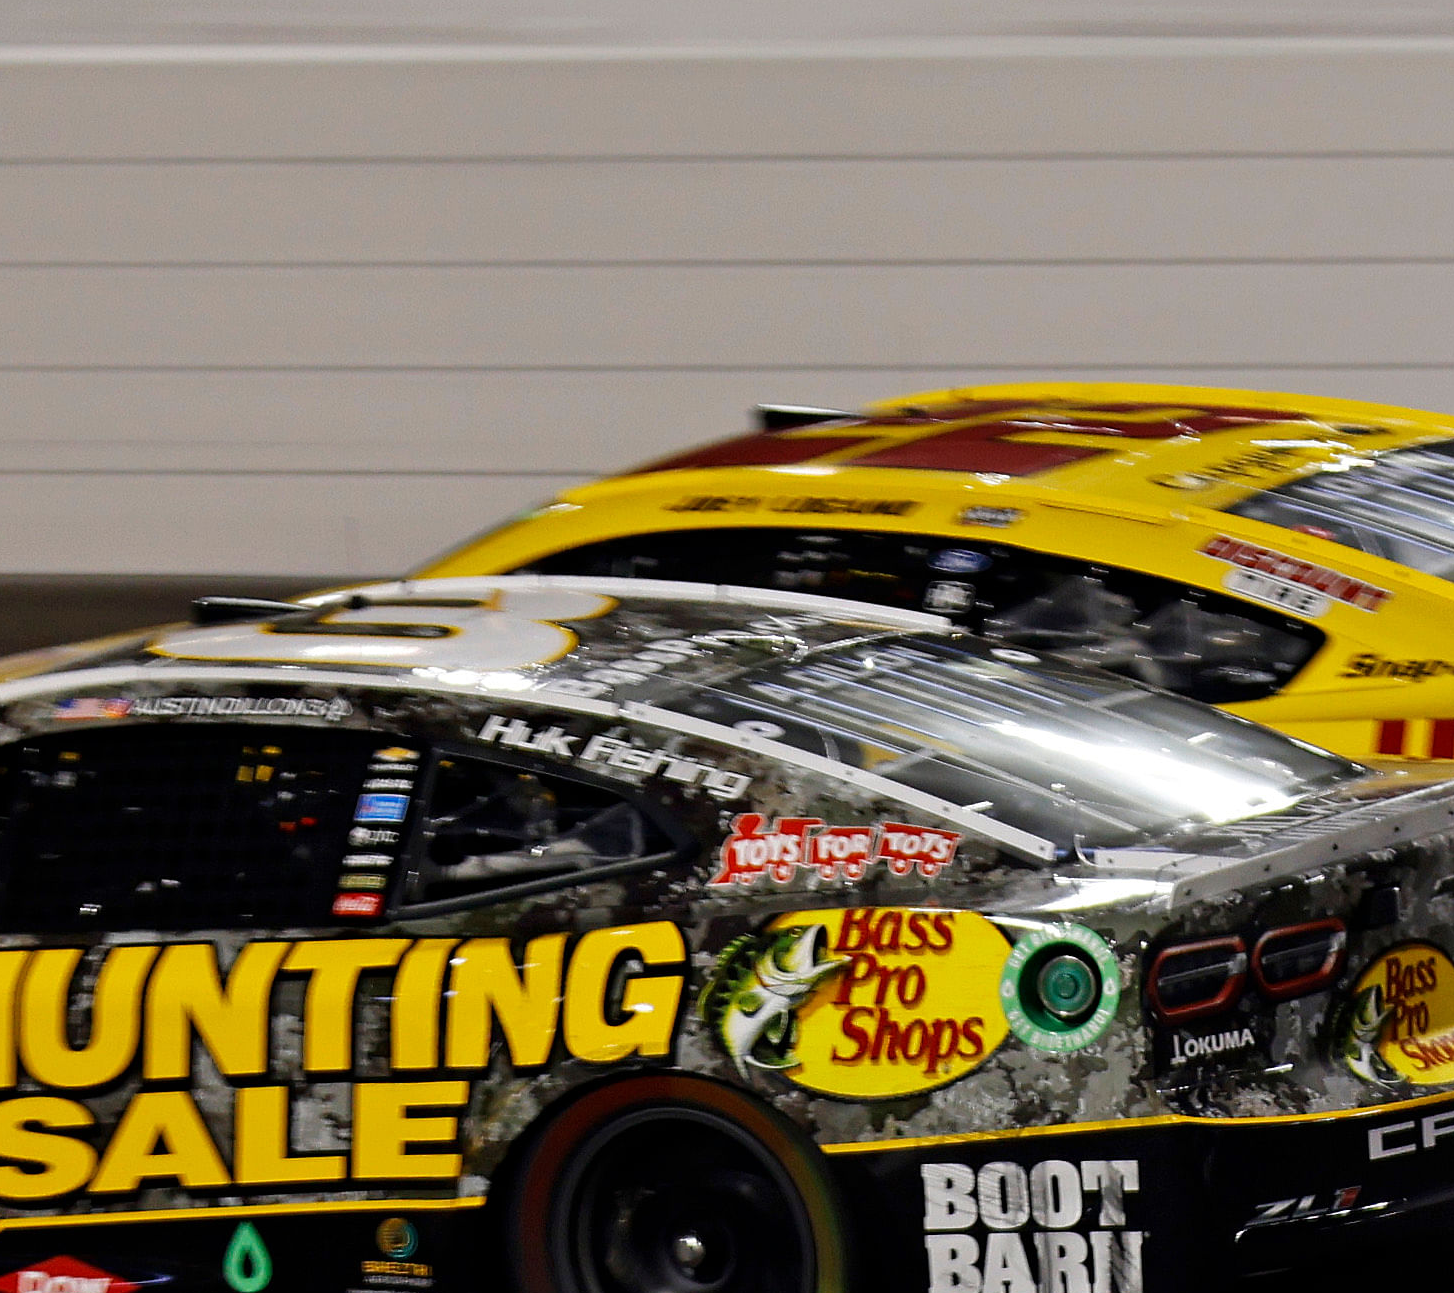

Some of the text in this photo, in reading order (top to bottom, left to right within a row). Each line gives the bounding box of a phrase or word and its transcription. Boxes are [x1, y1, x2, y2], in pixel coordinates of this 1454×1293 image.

[477, 712, 755, 800] Huk Fishing
[732, 830, 952, 866] TOYS FOR TOTS
[833, 907, 956, 954] Bass
[831, 951, 927, 1007] Pro
[1384, 956, 1438, 1004] Bass
[832, 1007, 985, 1078] Shops
[1388, 1003, 1428, 1042] Pro
[922, 1160, 1140, 1232] BOOT
